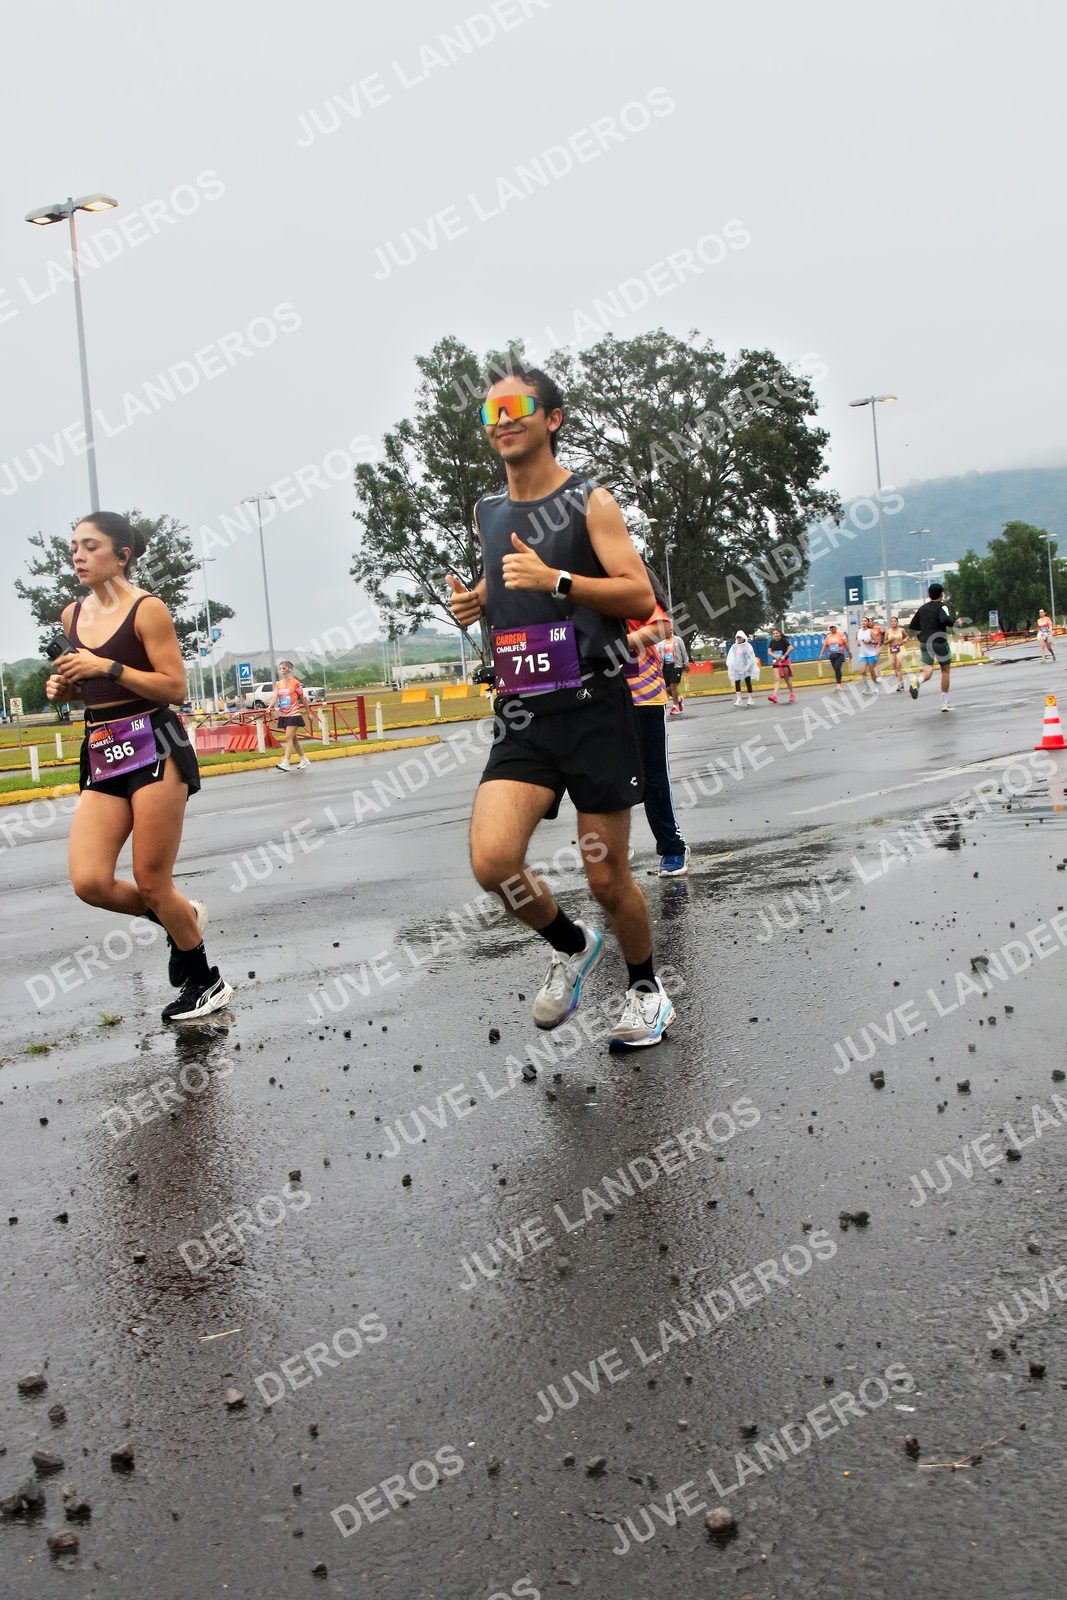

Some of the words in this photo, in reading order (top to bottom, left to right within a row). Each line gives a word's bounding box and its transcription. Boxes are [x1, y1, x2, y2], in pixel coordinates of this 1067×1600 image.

[848, 588, 860, 602] E
[549, 627, 567, 642] 15K
[512, 652, 551, 675] 715
[104, 741, 135, 763] 586
